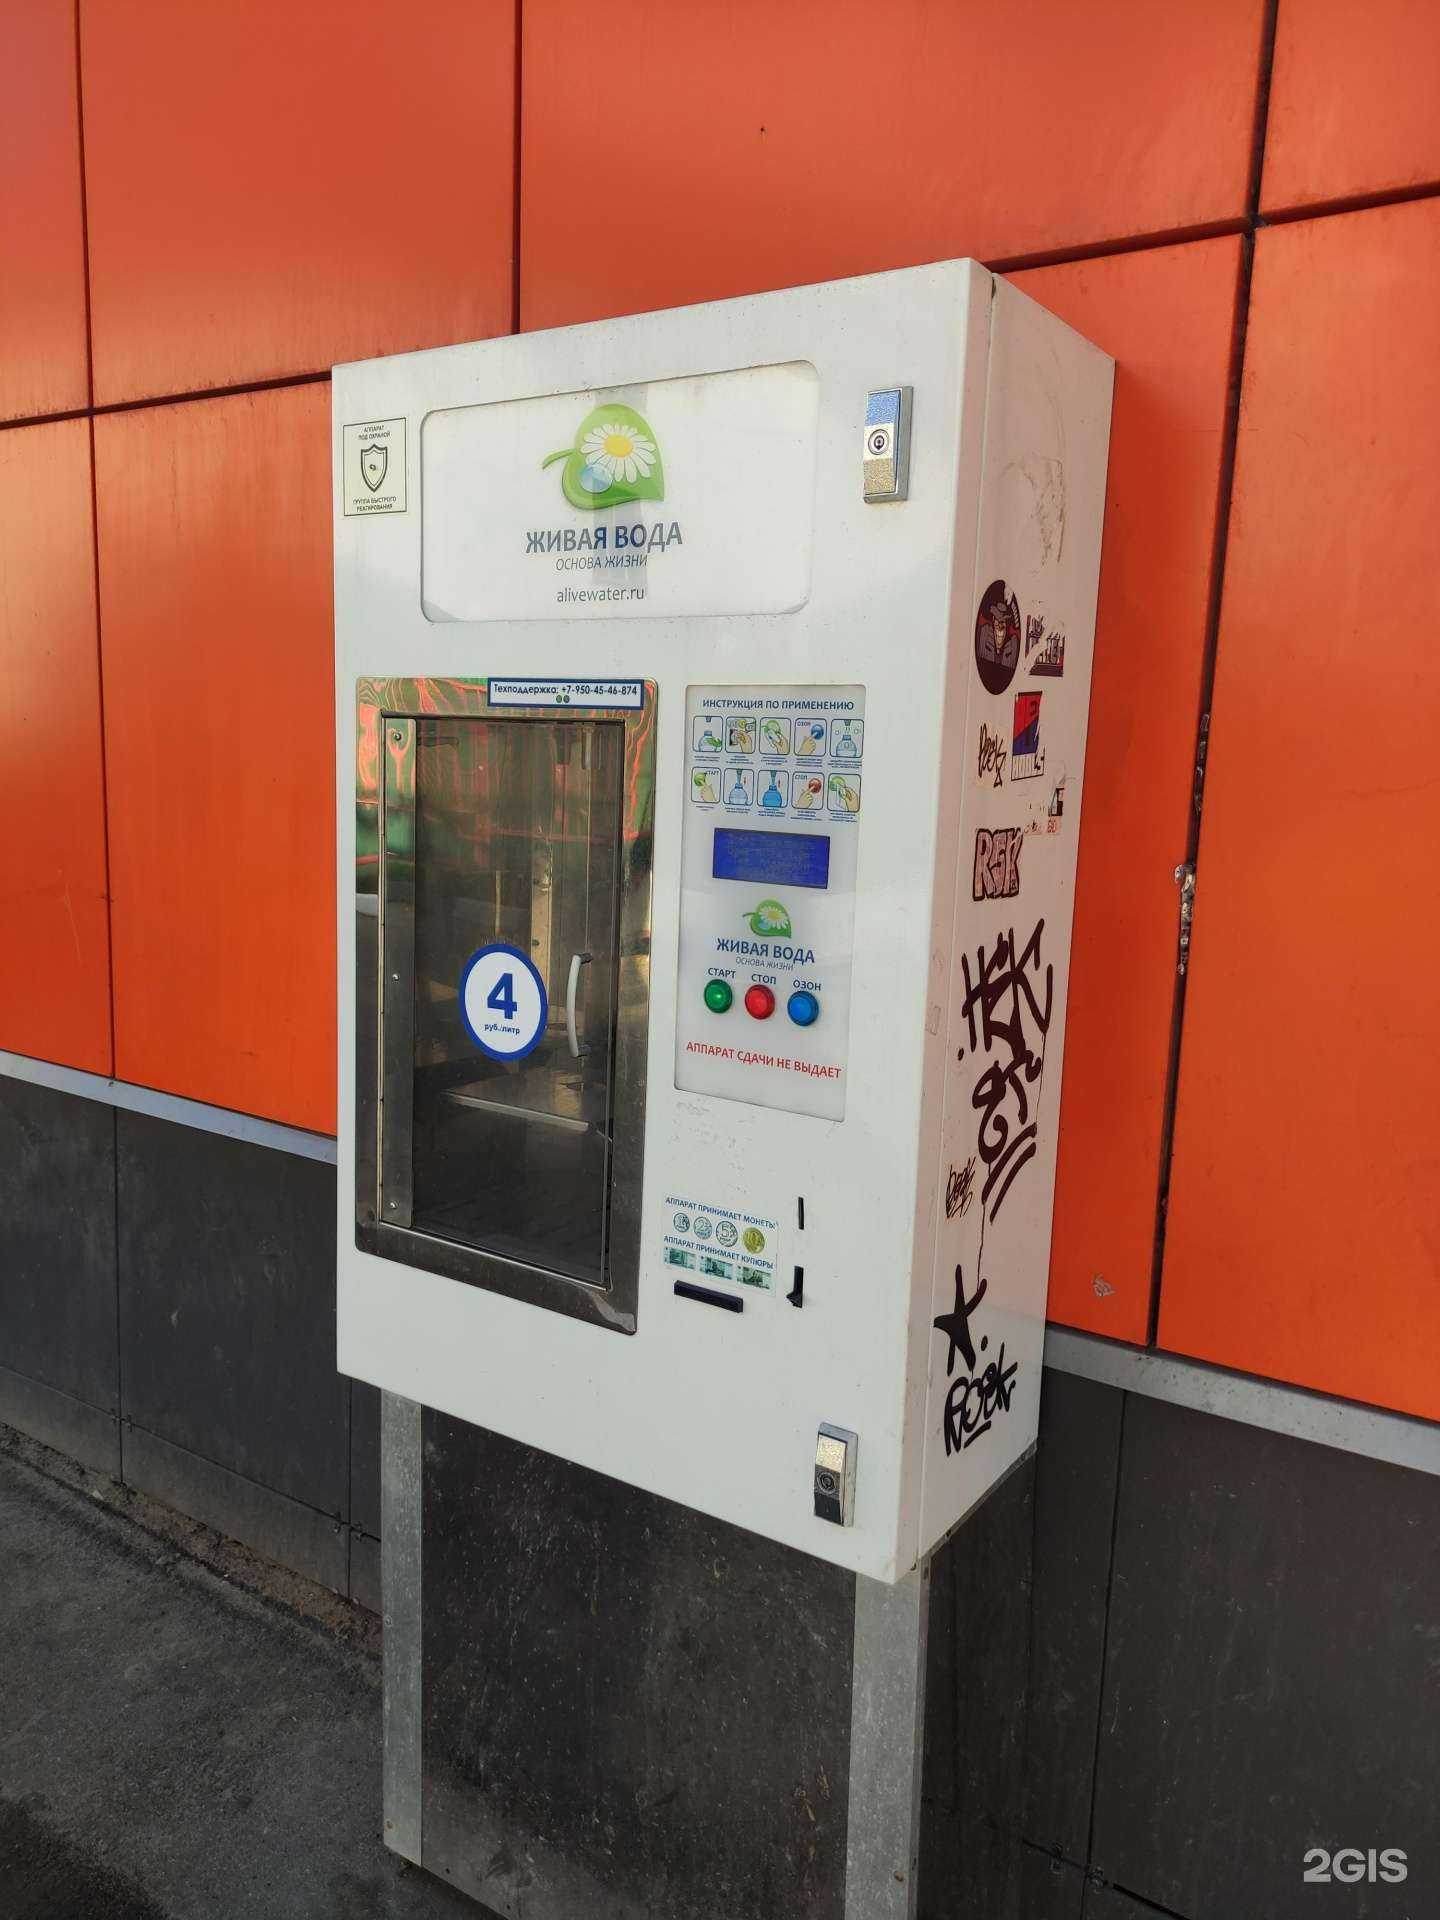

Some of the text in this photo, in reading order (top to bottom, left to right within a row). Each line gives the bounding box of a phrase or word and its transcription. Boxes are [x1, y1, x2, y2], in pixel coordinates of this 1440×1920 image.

[526, 521, 683, 554] ЖИВАЯ ВОДА
[556, 554, 648, 571] ОСНОВА ЖИЗНИ
[556, 587, 645, 602] alivewater.ru
[494, 683, 637, 695] Техподдержка: +7-950-45-46-874
[702, 699, 855, 711] ИНСТРУКЦИЯ ПО ПРИМЕНЕНИЮ
[716, 938, 815, 966] ЖИВАЯ ВОДА
[735, 956, 794, 972] ОСНОВА ЖИЗНИ
[707, 967, 736, 979] СТАРТ
[751, 973, 777, 985] СТОП
[793, 979, 821, 991] ОЗОН
[487, 973, 518, 1020] 4
[484, 1023, 520, 1035] руб./литр
[686, 1041, 842, 1079] АППАРАТ СДАЧИ НЕ ВЫДАЕТ
[665, 1197, 776, 1229] АППАРАТ ПРИНИМАЕТ МОНЕТЫ
[664, 1235, 774, 1270] АППАРАТ ПРИНИМАЕТ КУПЮРЫ
